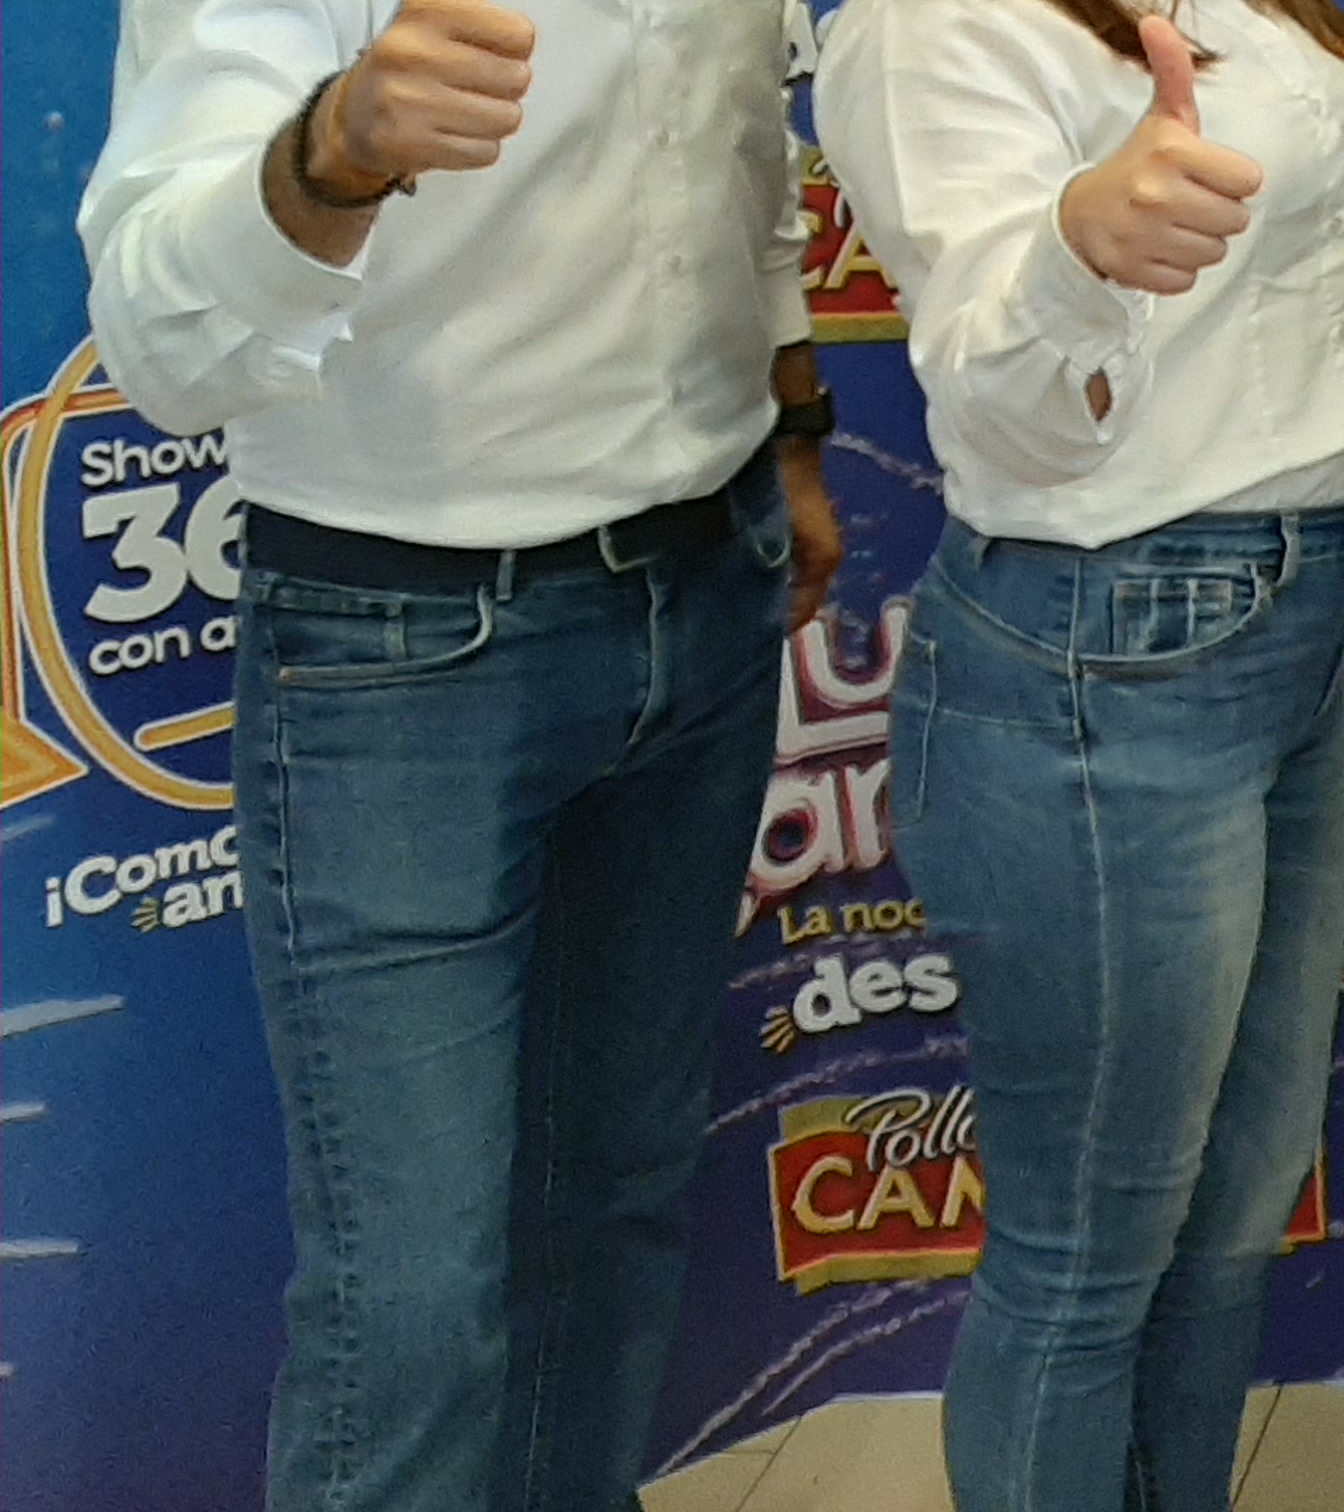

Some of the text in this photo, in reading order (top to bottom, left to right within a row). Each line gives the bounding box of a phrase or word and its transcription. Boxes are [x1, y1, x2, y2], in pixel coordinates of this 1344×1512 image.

[89, 626, 190, 675] con
[777, 898, 928, 945] La noc
[792, 952, 958, 1033] des
